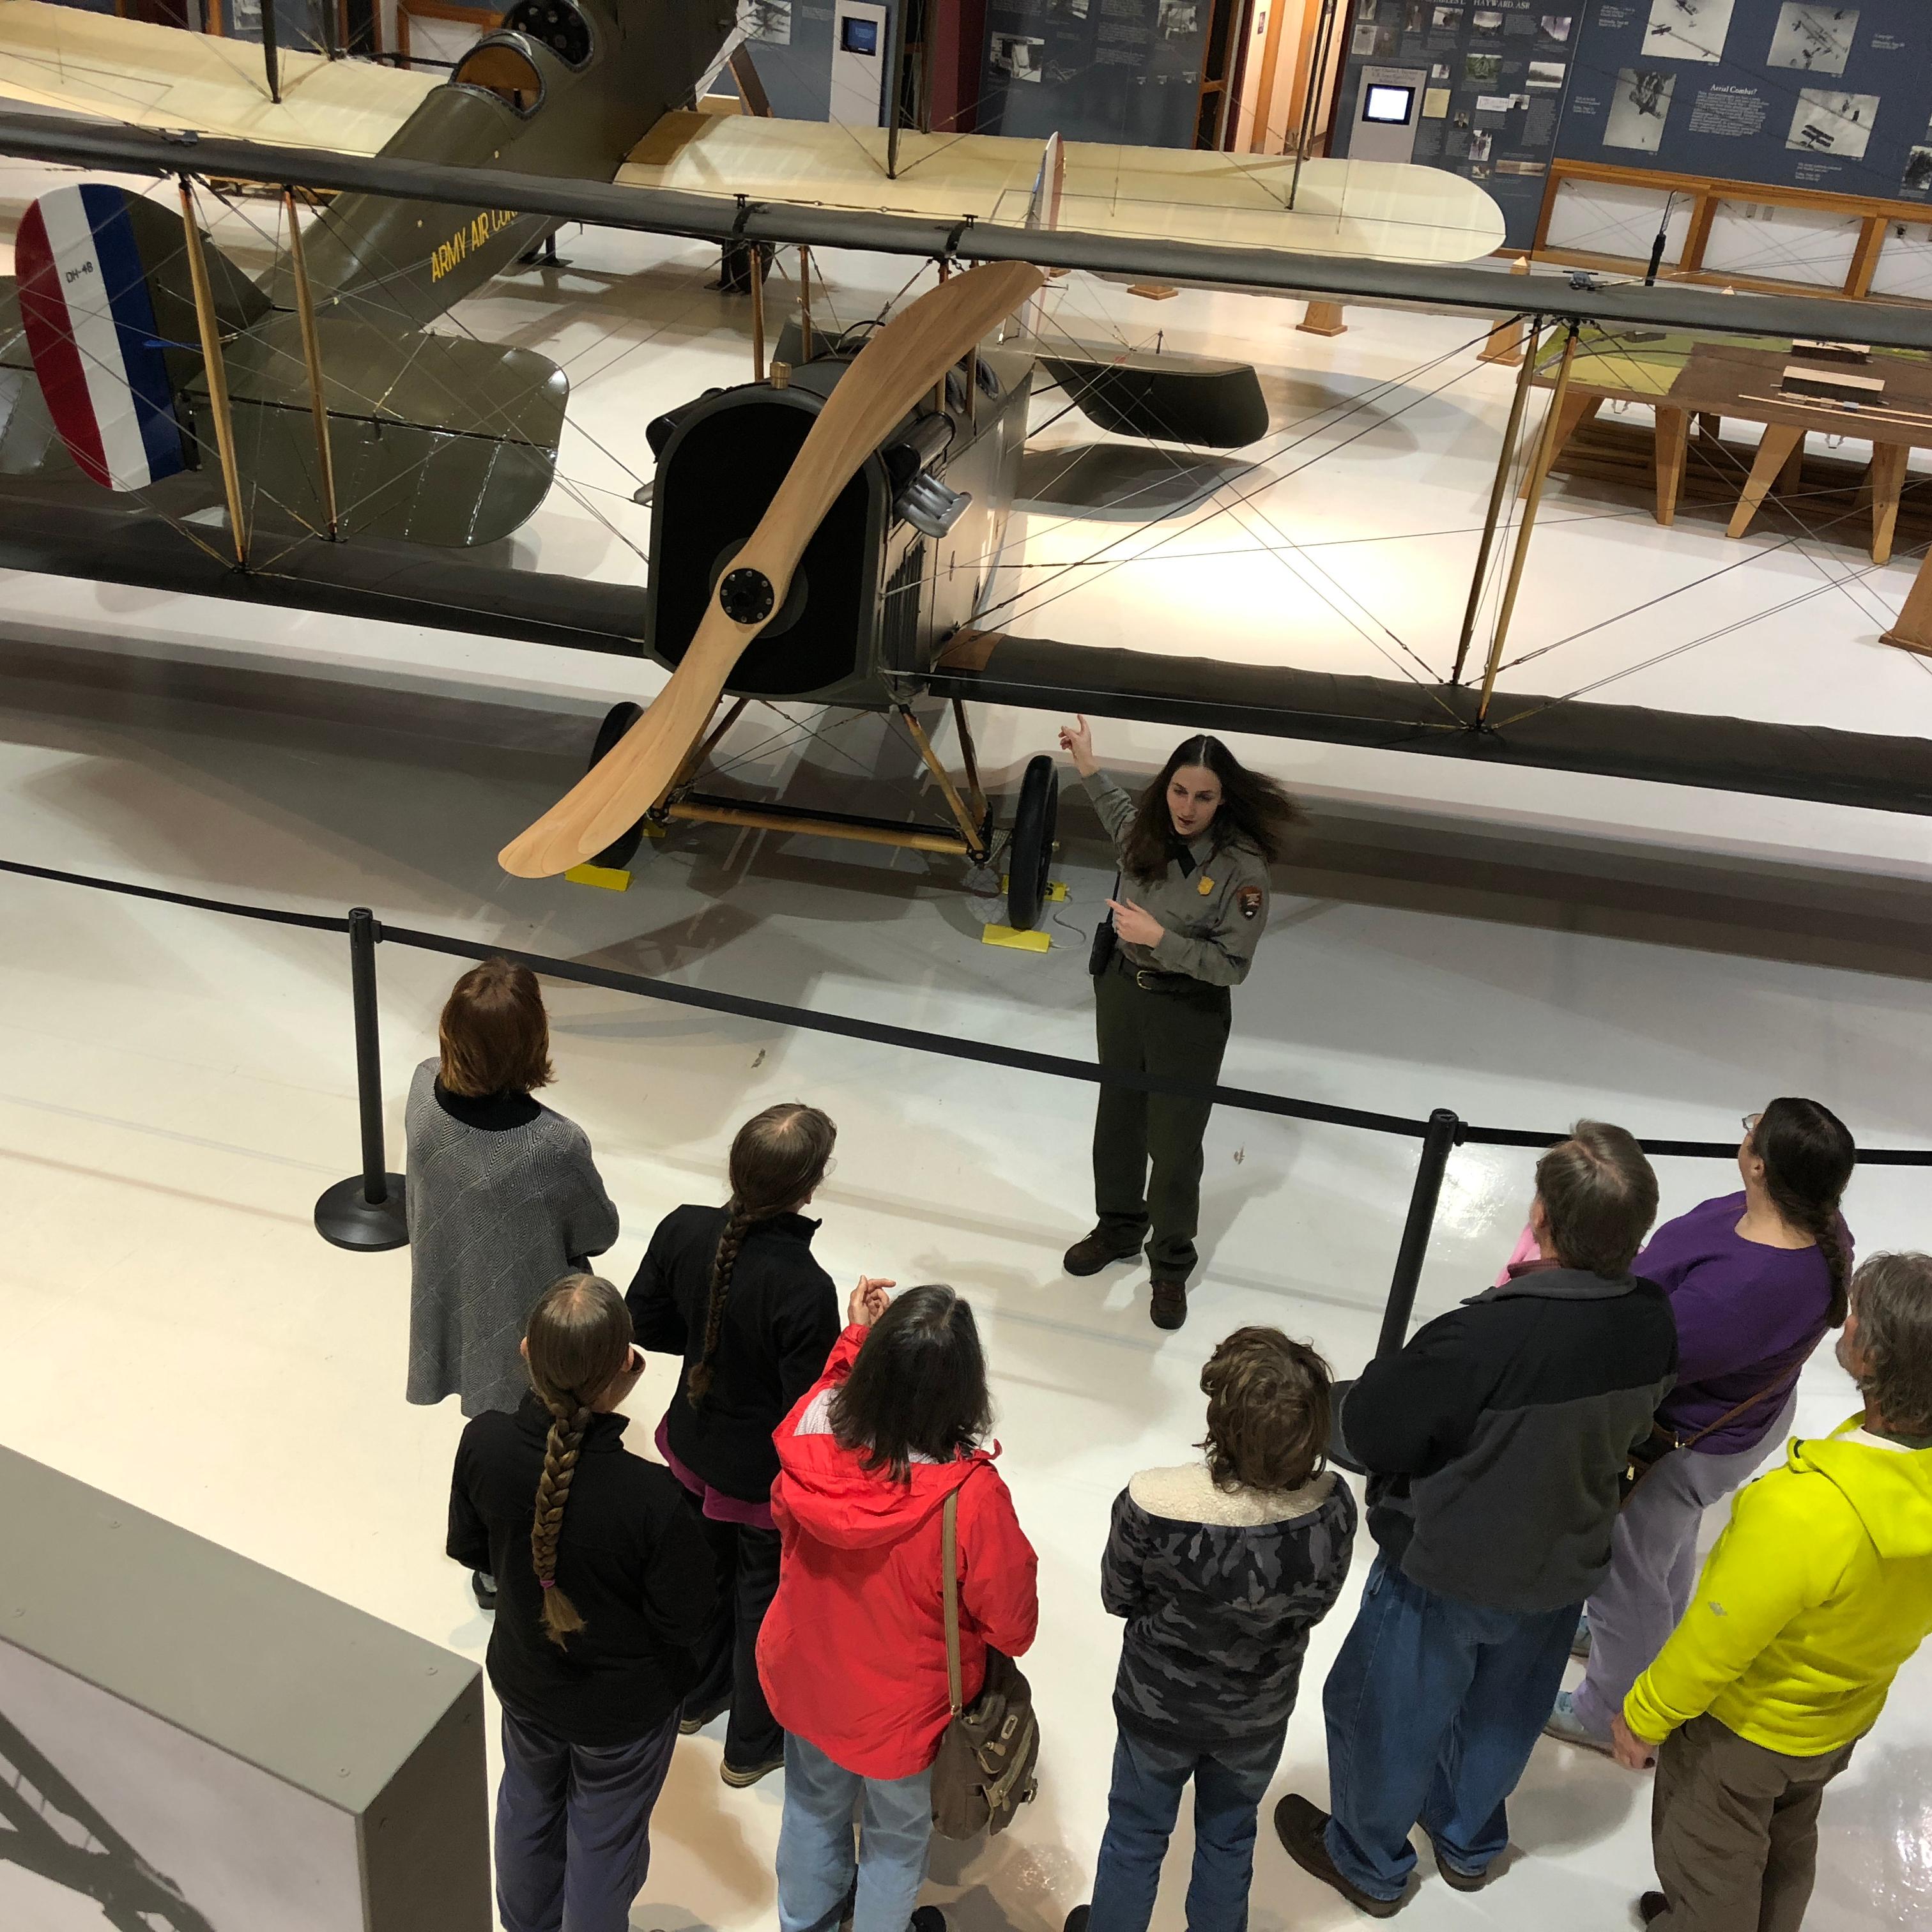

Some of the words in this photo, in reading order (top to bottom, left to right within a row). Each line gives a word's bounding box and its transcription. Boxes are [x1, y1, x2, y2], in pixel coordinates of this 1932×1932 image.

[1710, 84, 1729, 93] Aerial
[432, 227, 466, 283] ARMY
[471, 212, 489, 251] AIR
